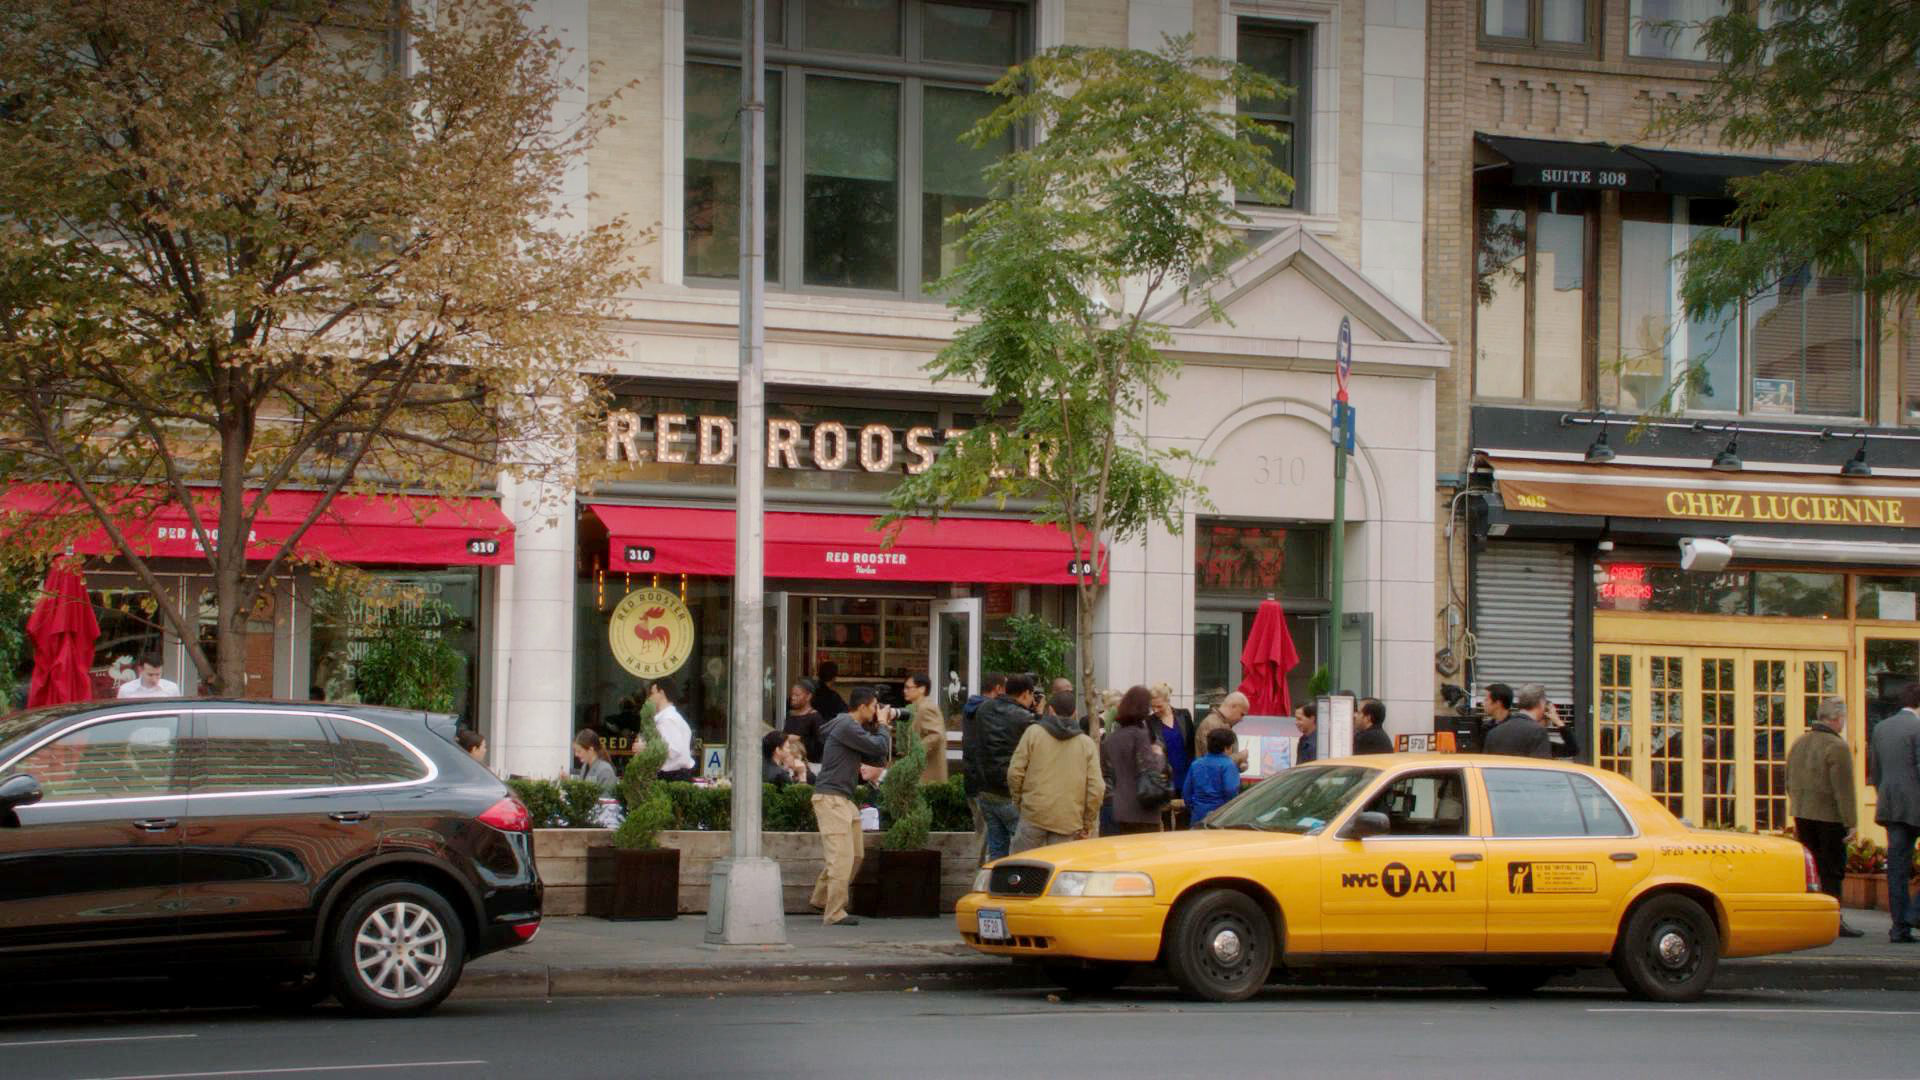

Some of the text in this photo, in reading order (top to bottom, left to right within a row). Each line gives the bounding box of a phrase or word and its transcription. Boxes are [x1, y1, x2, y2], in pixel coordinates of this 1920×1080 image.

[1541, 169, 1627, 186] SUITE 308
[606, 408, 734, 466] RED
[1255, 455, 1305, 486] 310
[1666, 491, 1905, 524] CHEZ LUCIENNE
[471, 542, 495, 553] 310
[629, 549, 650, 561] 310
[826, 551, 907, 565] RED ROOSTER
[1071, 563, 1091, 574] 30
[617, 592, 686, 621] RED ROOSTER
[626, 655, 679, 673] HARLEM
[707, 751, 721, 769] A
[1342, 863, 1456, 897] NYC TAXI
